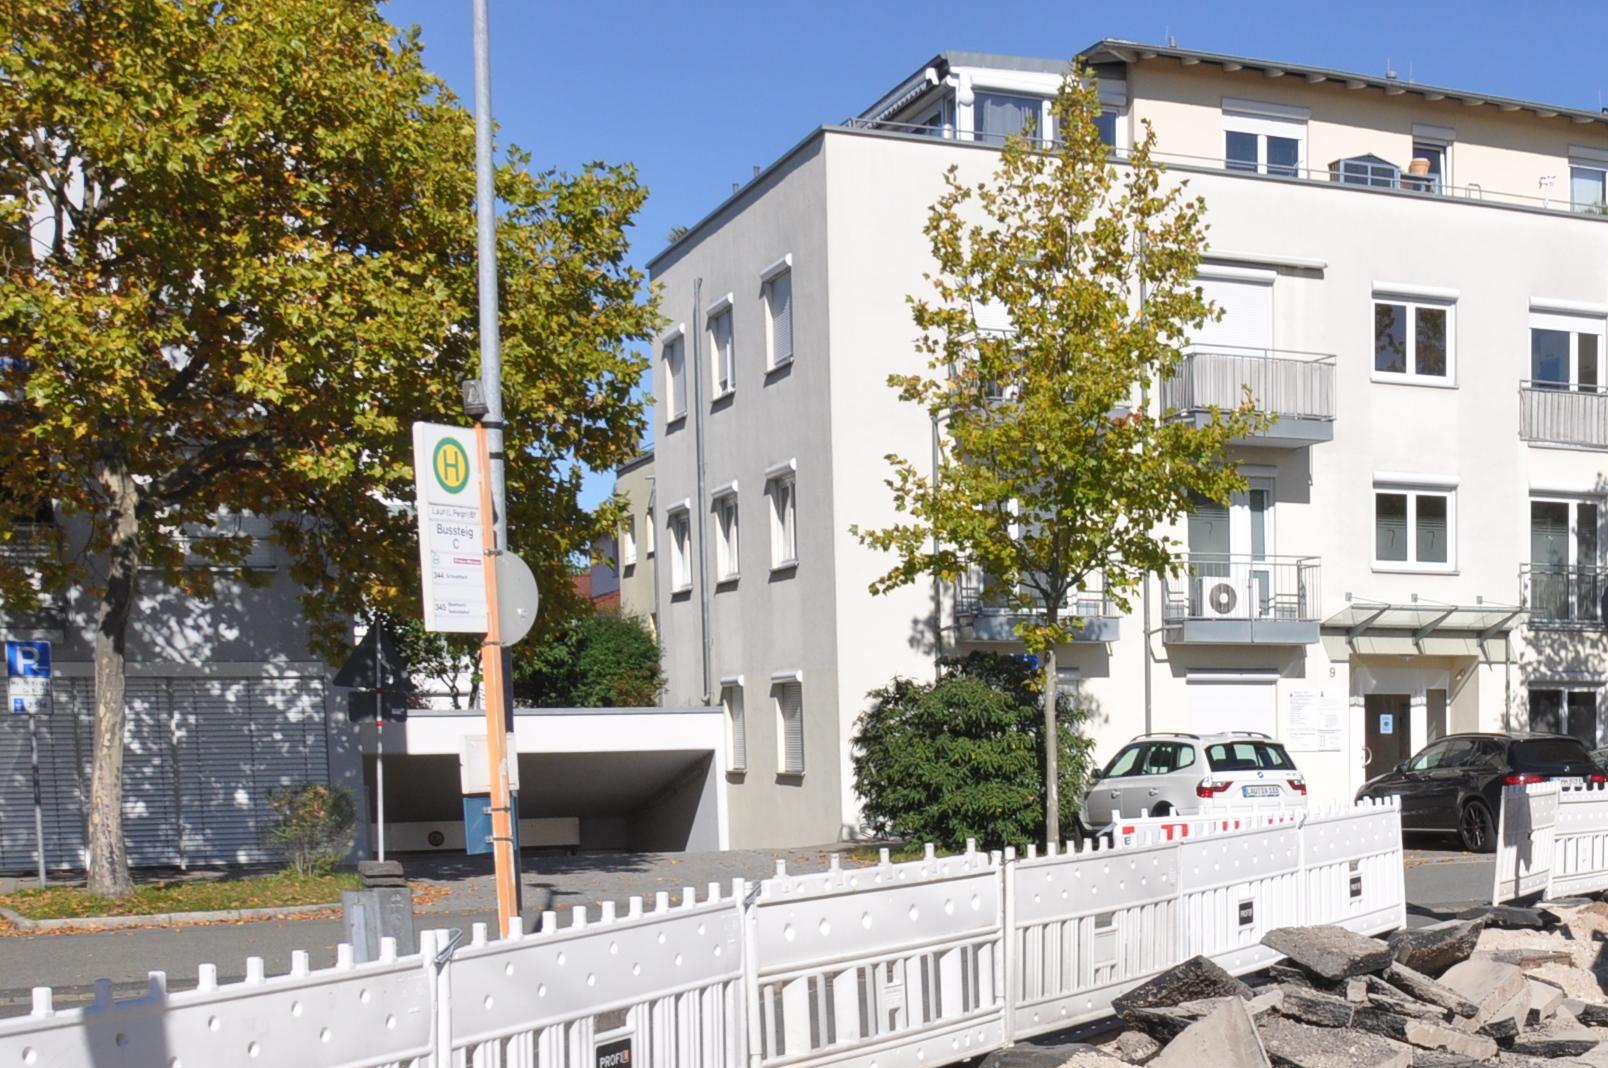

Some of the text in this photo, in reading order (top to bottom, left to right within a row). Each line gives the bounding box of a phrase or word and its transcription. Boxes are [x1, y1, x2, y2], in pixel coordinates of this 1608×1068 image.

[443, 449, 460, 482] H
[436, 523, 474, 539] Bussteig
[452, 538, 460, 549] C
[16, 646, 40, 675] P
[1329, 667, 1336, 678] 9
